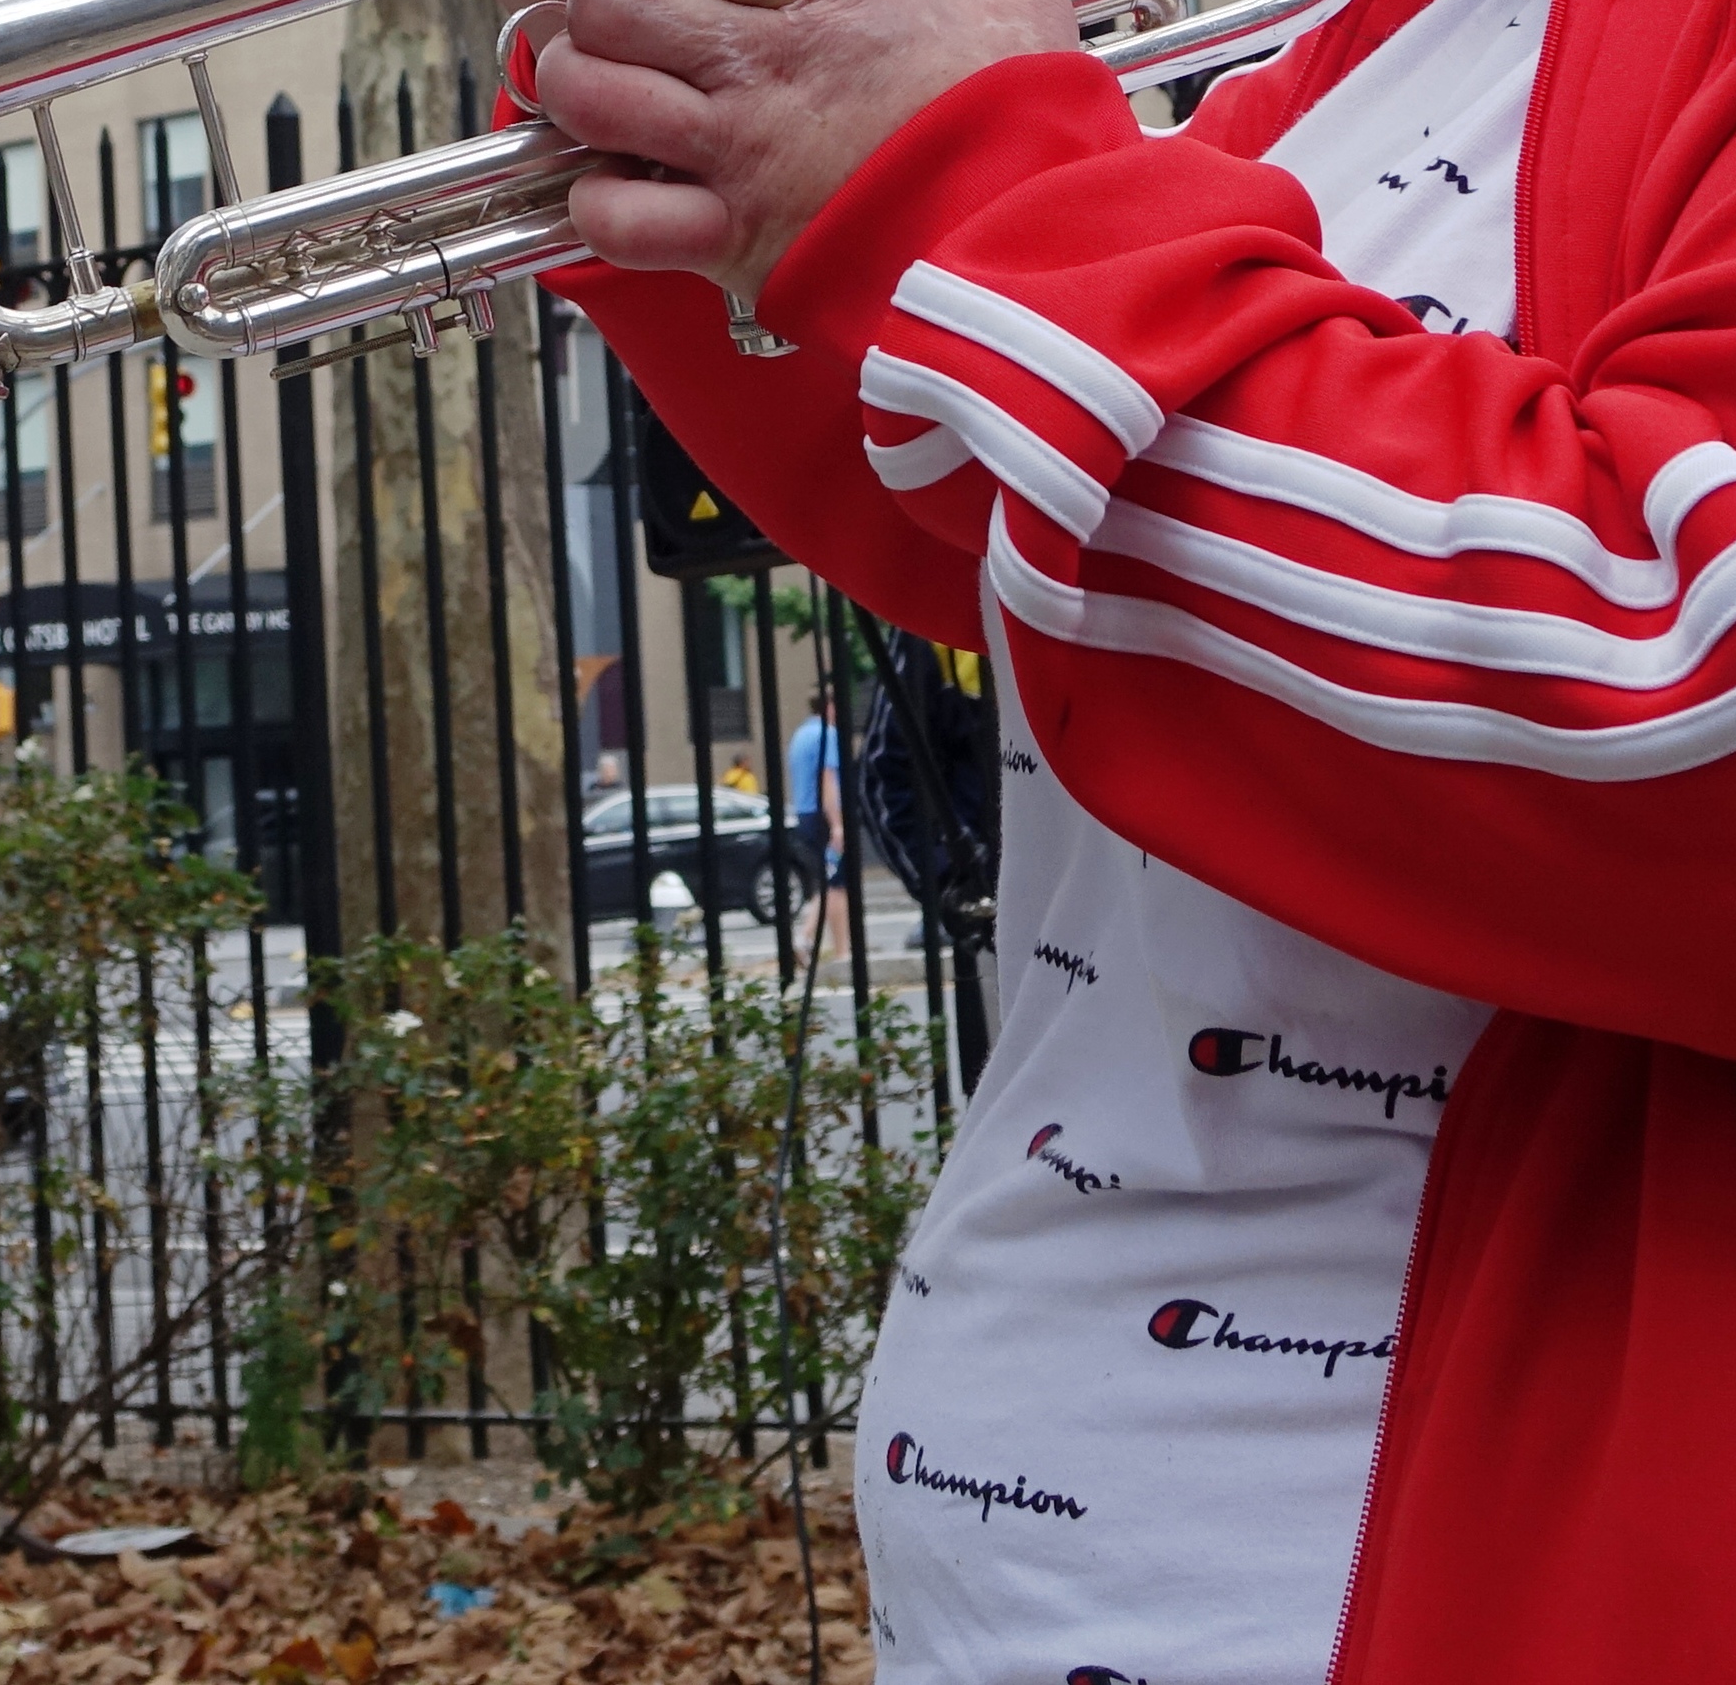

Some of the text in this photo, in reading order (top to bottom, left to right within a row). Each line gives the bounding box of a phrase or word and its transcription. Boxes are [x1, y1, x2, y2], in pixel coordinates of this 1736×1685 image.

[1188, 1027, 1449, 1119] Champi
[1148, 1299, 1396, 1378] Champi
[886, 1431, 1088, 1522] Champion
